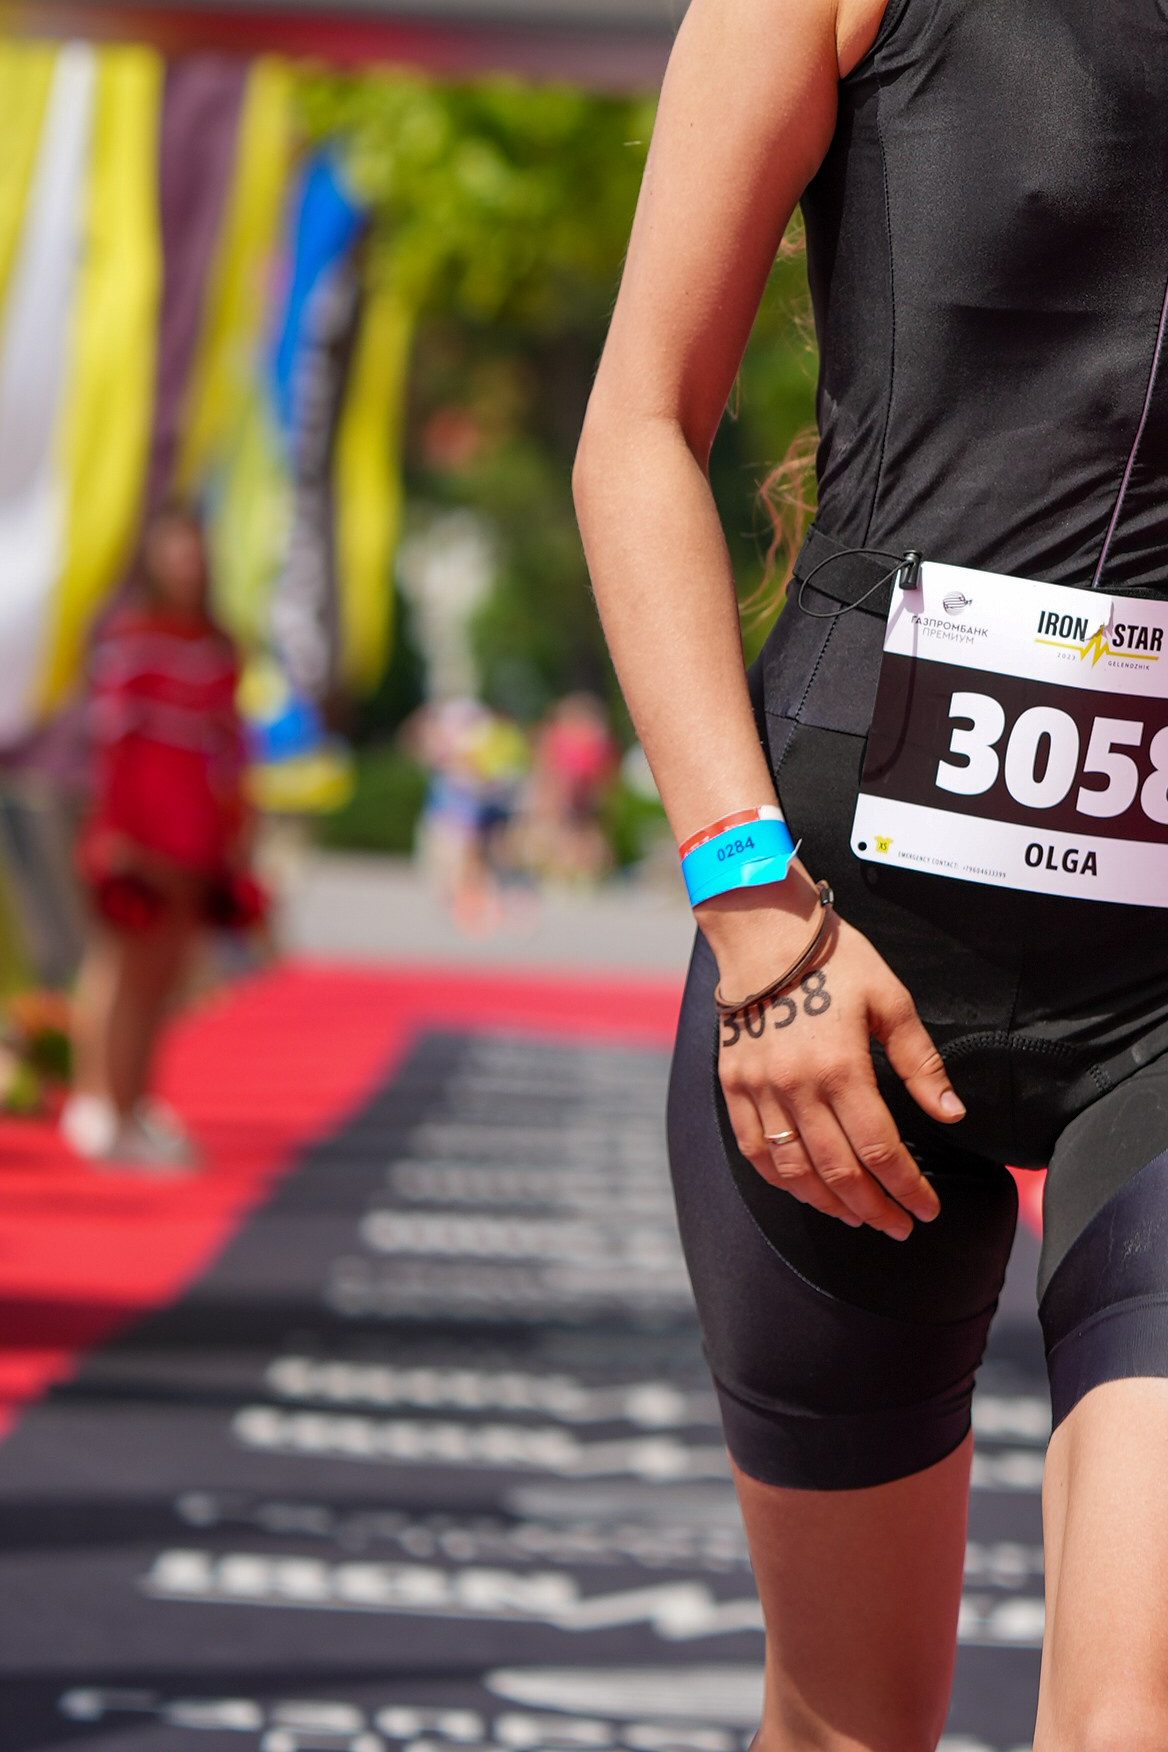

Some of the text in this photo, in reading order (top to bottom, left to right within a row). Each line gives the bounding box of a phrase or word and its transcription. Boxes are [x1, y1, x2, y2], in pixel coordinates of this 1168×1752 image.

[911, 615, 989, 637] ГАЗПРОМБАНК
[922, 627, 975, 645] ПРЕМИУМ
[1037, 610, 1164, 651] IRON STAR
[1057, 652, 1150, 671] 2023 GELENDZHIK
[717, 836, 755, 862] 0284
[879, 841, 888, 851] XS
[898, 851, 931, 864] EMERGENCY
[1024, 843, 1098, 876] OLGA
